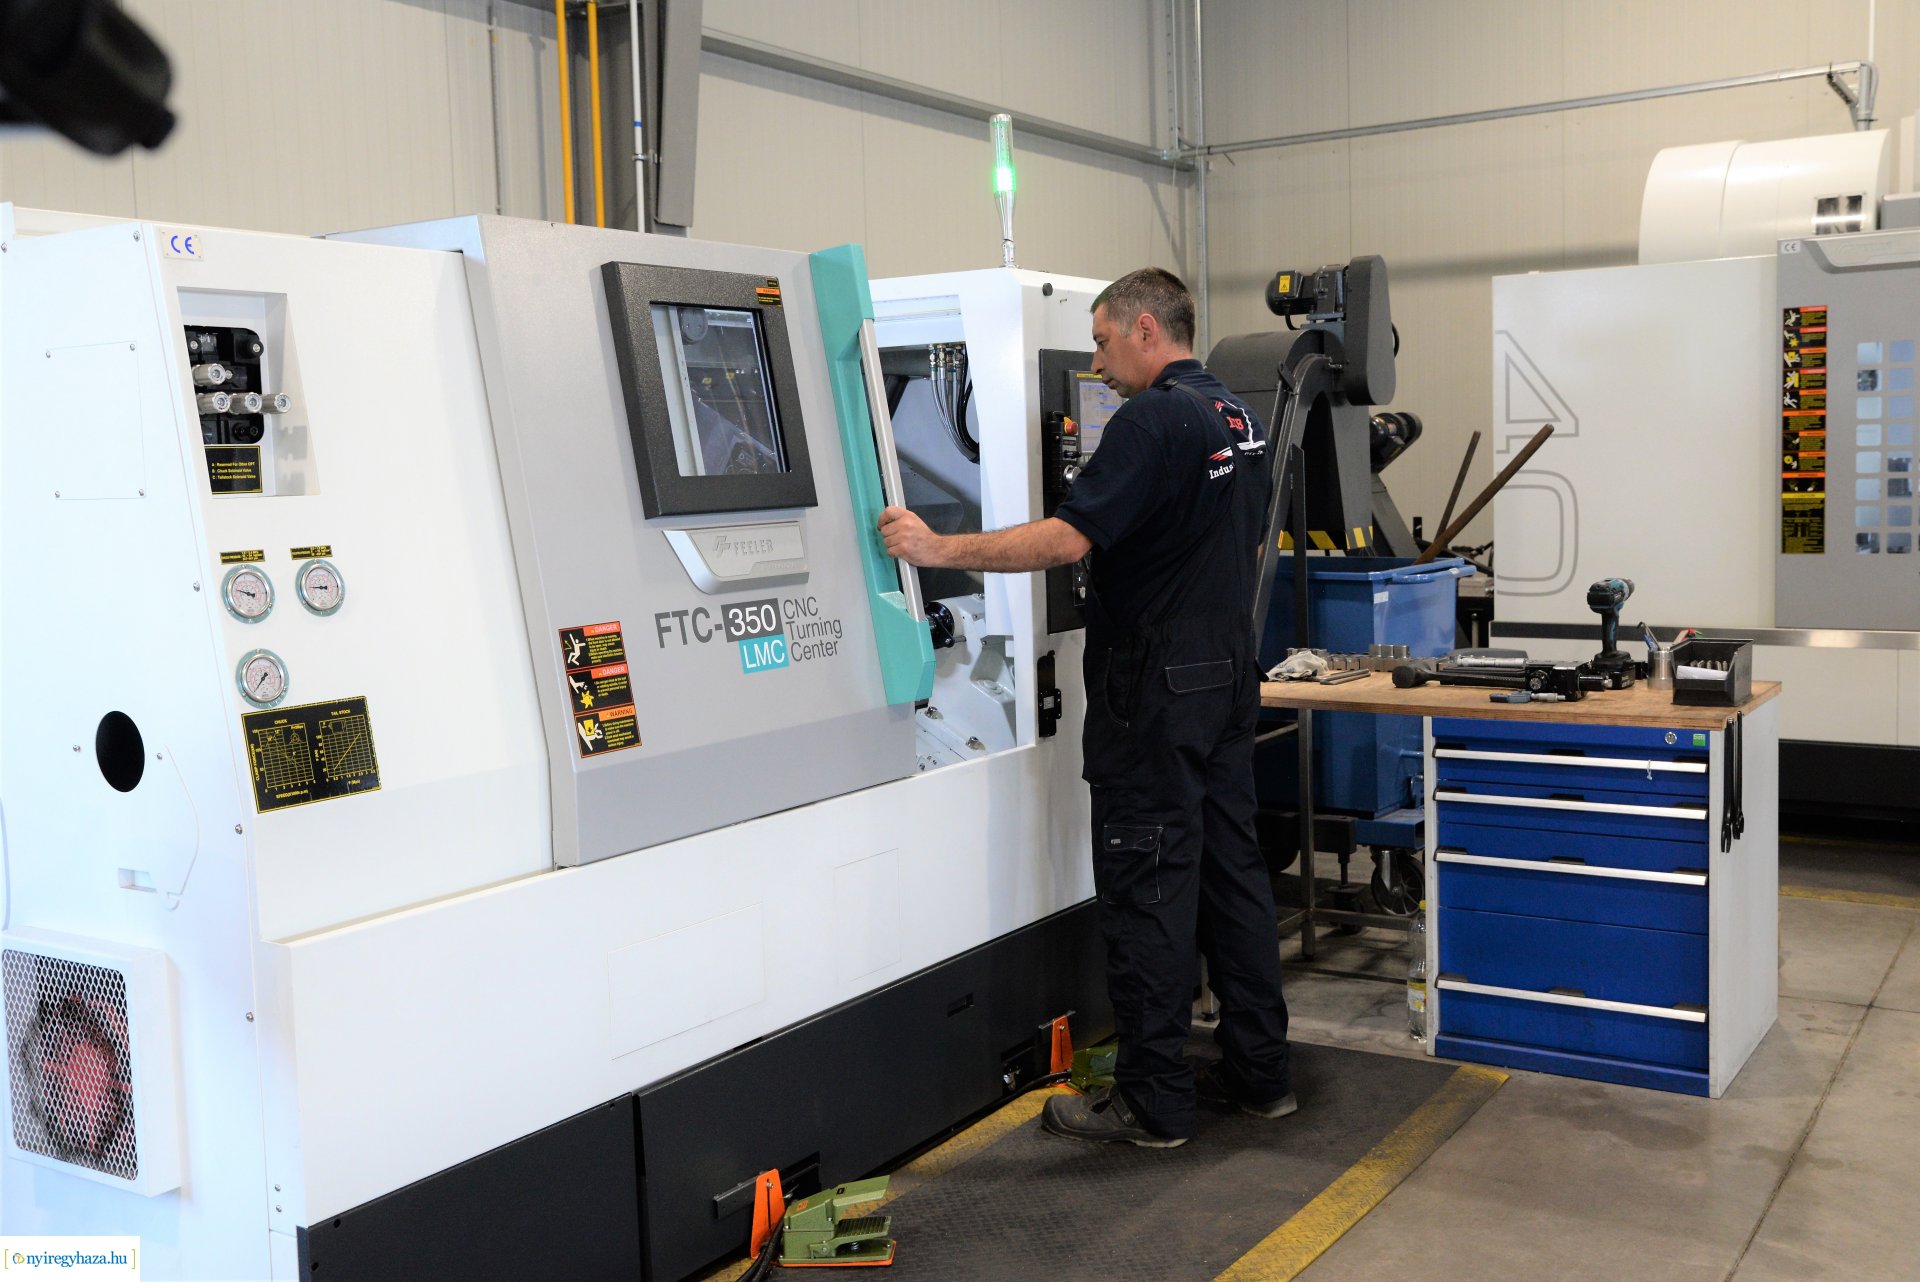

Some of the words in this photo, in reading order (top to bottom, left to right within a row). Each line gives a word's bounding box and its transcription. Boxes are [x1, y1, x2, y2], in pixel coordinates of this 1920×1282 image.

[170, 235, 195, 255] CE
[1208, 462, 1235, 480] Indus
[783, 596, 819, 620] CNC
[594, 624, 617, 632] DANGER
[785, 617, 843, 641] Turning
[743, 639, 785, 669] LMC
[790, 640, 839, 662] Center
[602, 666, 625, 676] DANGER
[609, 708, 633, 718] WARNING
